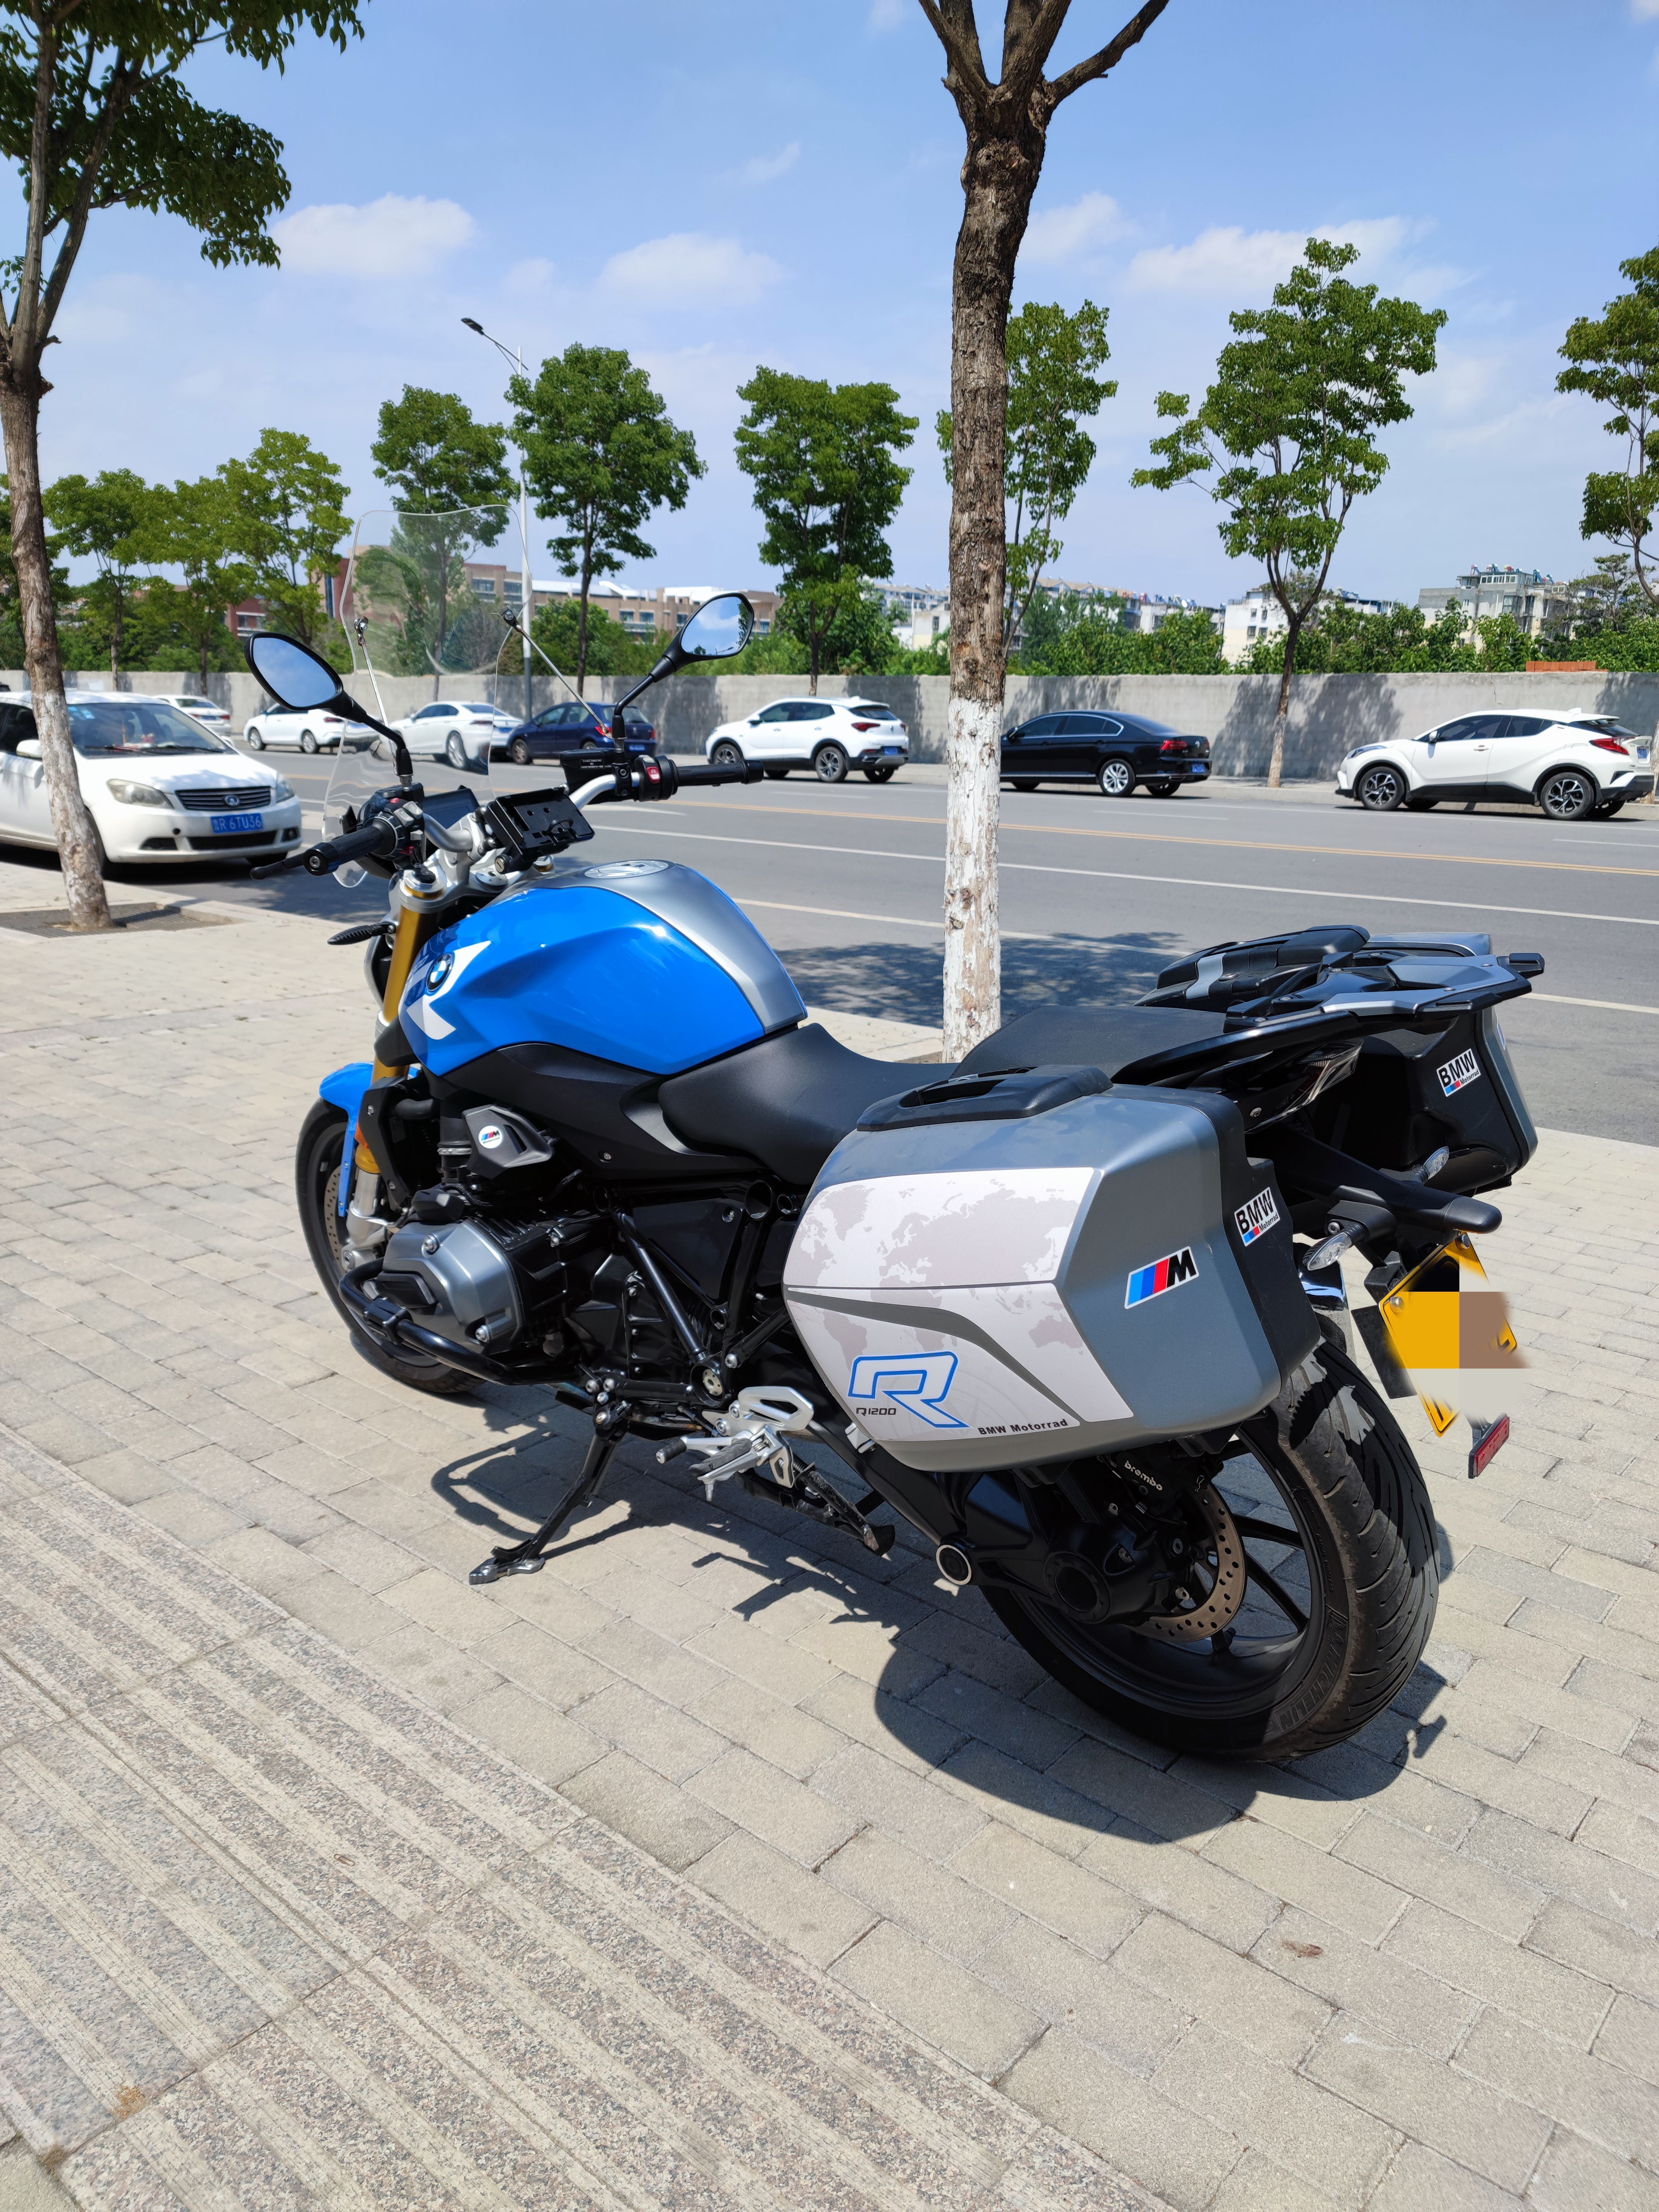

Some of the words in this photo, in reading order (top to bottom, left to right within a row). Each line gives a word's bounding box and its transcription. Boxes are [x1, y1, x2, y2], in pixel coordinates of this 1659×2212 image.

[1438, 1050, 1475, 1088] BMW
[1460, 1068, 1479, 1085] Motorrad
[1236, 1189, 1274, 1235] BMW
[1258, 1212, 1279, 1232] Motorrad
[1166, 1249, 1197, 1288] M
[848, 1351, 971, 1428] R
[856, 1408, 896, 1416] R1200
[977, 1426, 1007, 1435] BMW
[1010, 1419, 1068, 1432] Motorrad
[1124, 1460, 1163, 1491] brembo
[1279, 1644, 1340, 1731] MICHELIN
